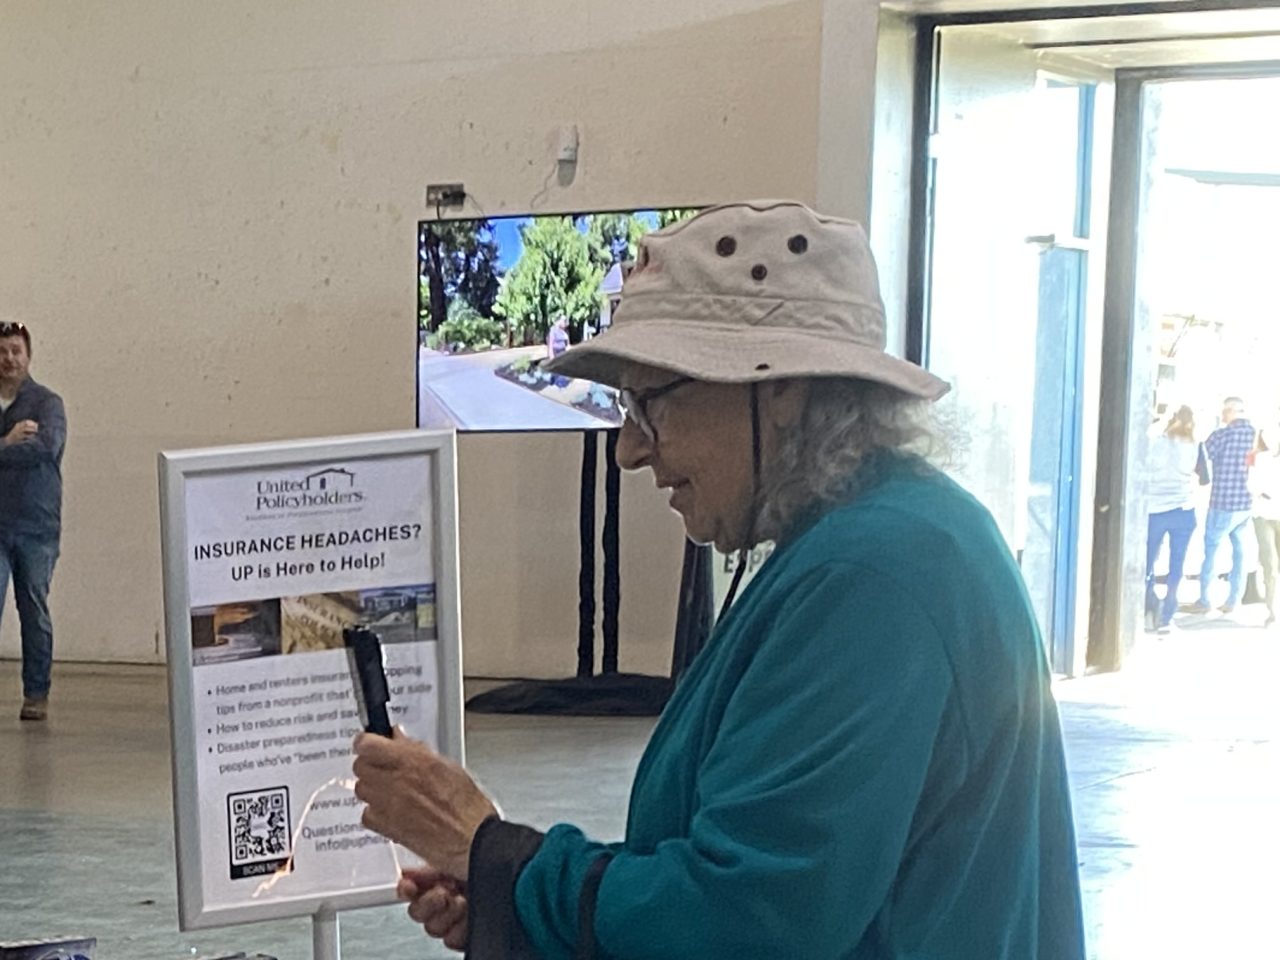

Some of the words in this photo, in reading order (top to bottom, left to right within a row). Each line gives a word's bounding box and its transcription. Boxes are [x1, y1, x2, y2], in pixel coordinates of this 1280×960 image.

[256, 477, 311, 495] United
[255, 490, 365, 512] Policyholders
[194, 535, 296, 561] INSURANCE
[300, 523, 422, 550] HEADACHES?
[231, 564, 254, 582] UP
[258, 563, 271, 580] is
[276, 560, 315, 578] Here
[320, 559, 336, 574] to
[341, 552, 386, 571] Help!
[216, 684, 246, 696] Home
[248, 679, 267, 693] and
[269, 676, 309, 689] renters
[216, 704, 236, 716] tips
[238, 701, 263, 713] from
[264, 699, 271, 708] a
[272, 692, 324, 707] nonprofit
[407, 681, 433, 693] side
[216, 722, 240, 735] How
[241, 721, 253, 732] to
[254, 716, 292, 730] reduce
[293, 713, 314, 725] risk
[316, 709, 338, 722] and
[216, 739, 261, 754] Disaster
[262, 730, 337, 749] preparedness
[218, 760, 255, 775] people
[256, 754, 293, 769] who've
